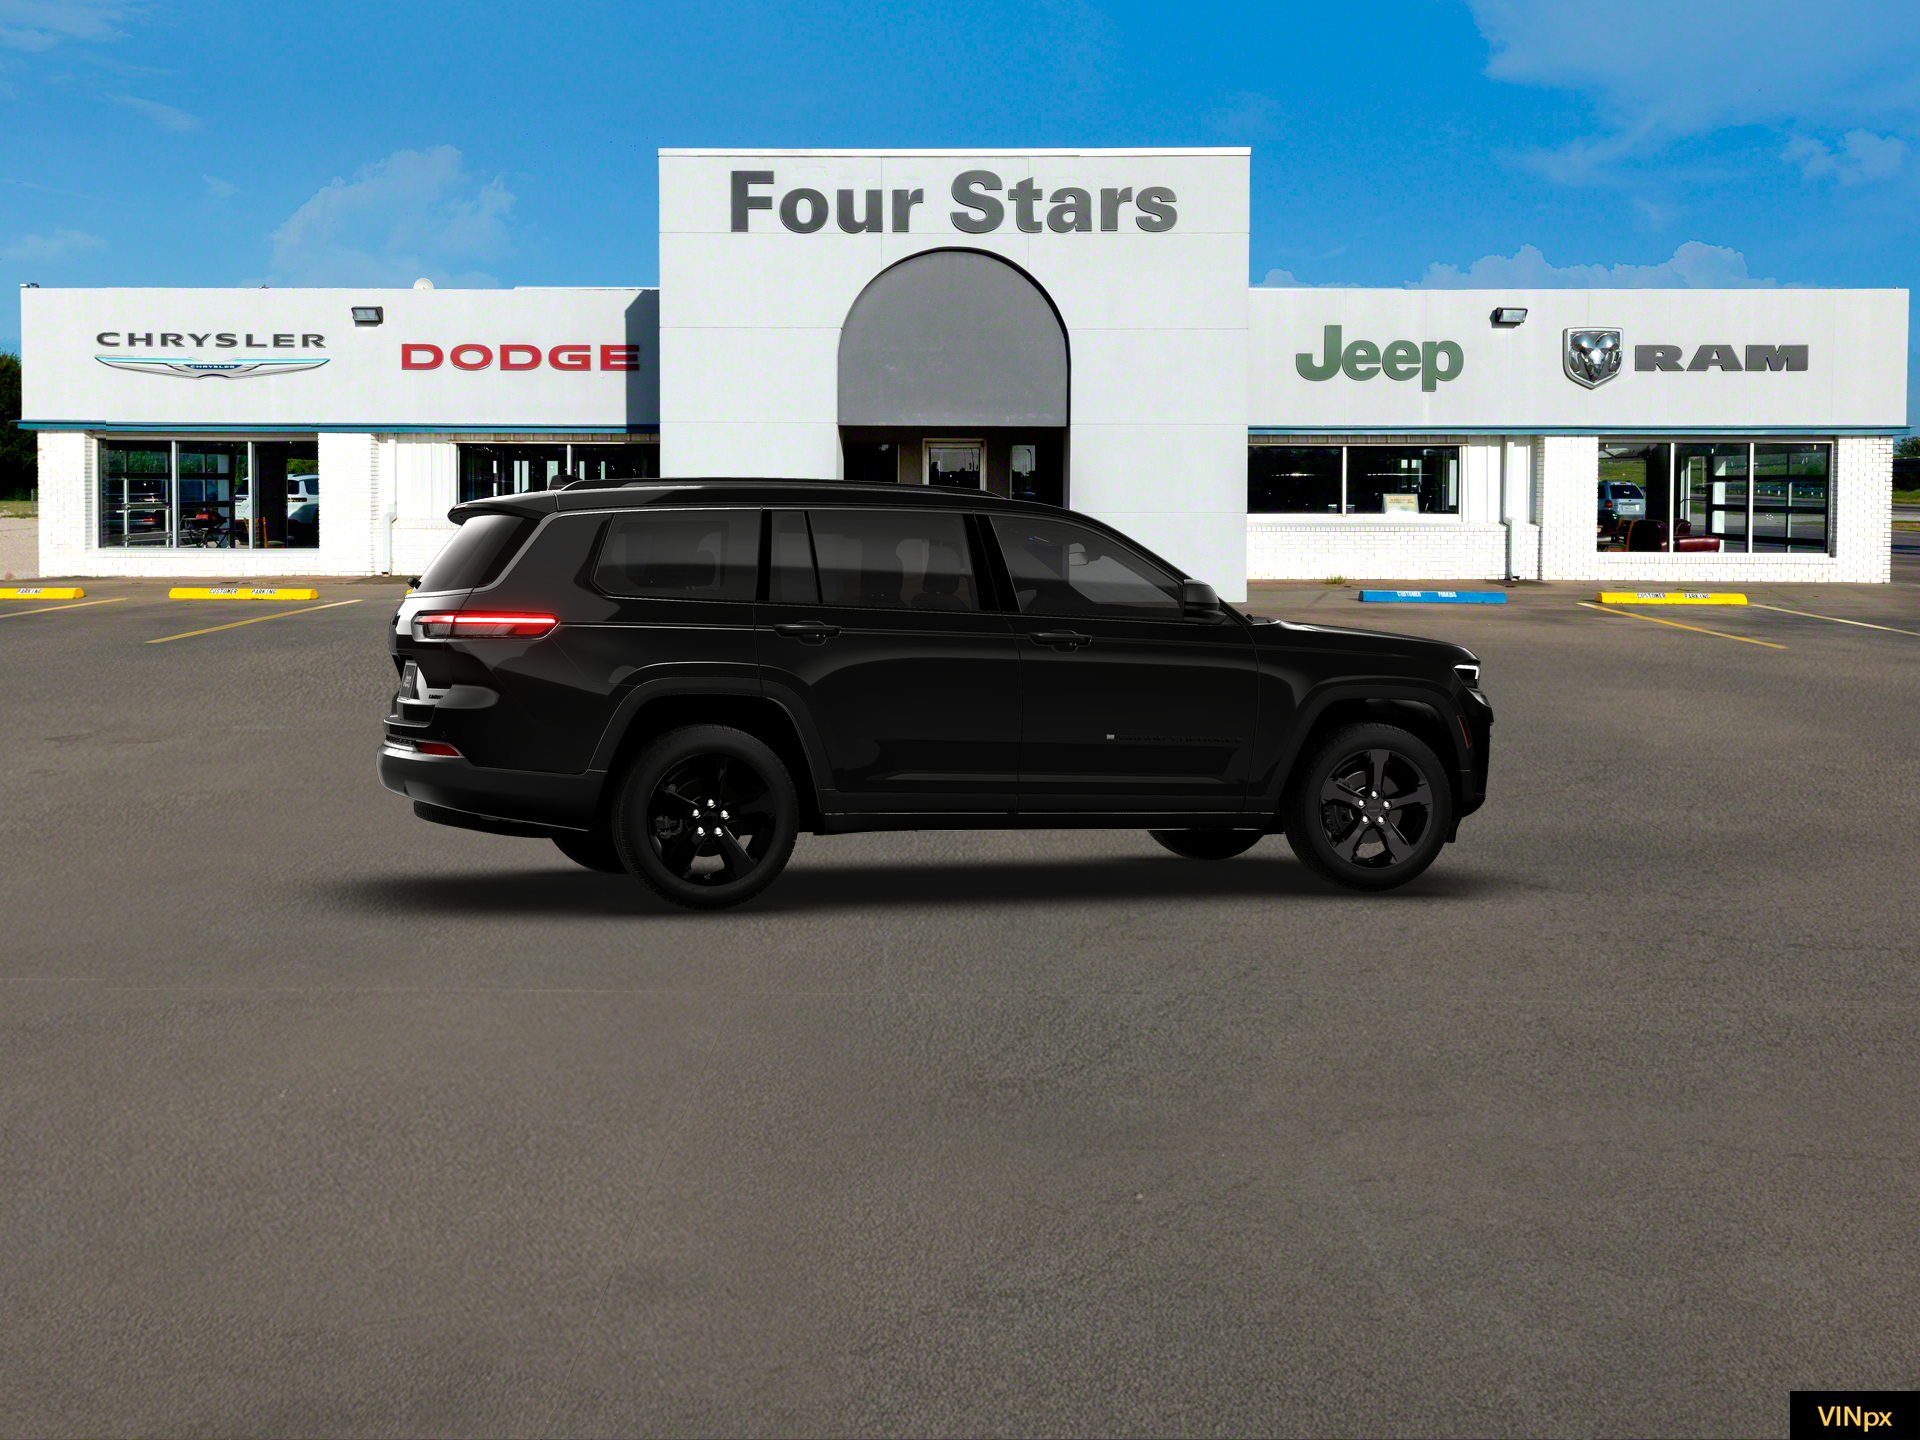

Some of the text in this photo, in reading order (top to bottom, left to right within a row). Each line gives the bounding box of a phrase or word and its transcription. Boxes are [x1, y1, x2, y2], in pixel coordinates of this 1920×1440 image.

[730, 169, 1178, 234] Four Stars
[96, 332, 326, 348] CHRYSLER
[401, 343, 640, 371] DODGE
[1295, 325, 1464, 392] Jeep
[1635, 344, 1809, 371] RAM
